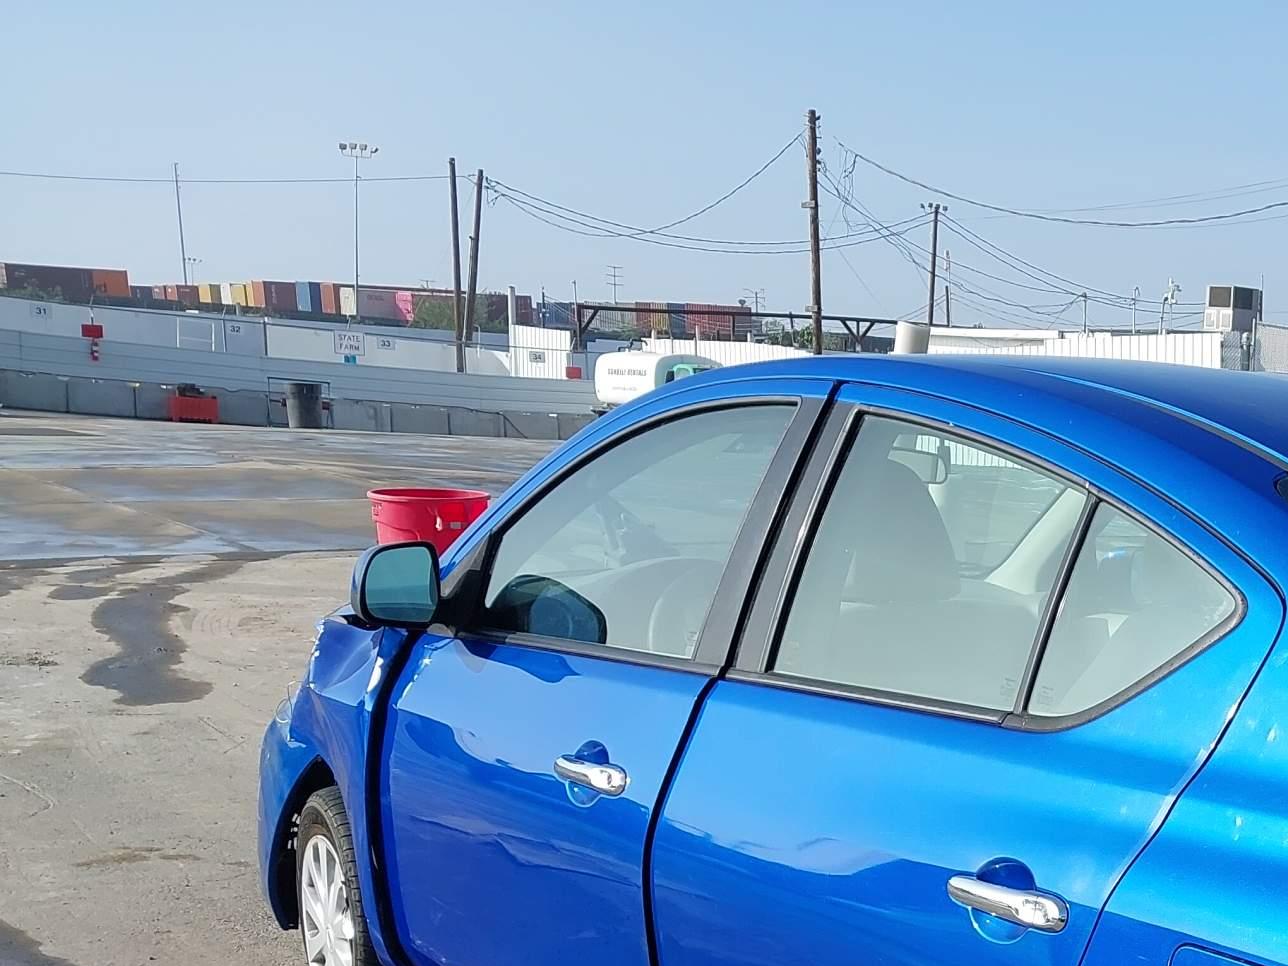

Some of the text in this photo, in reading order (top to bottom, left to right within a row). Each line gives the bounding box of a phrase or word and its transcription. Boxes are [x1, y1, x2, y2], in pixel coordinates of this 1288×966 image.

[35, 307, 47, 315] 31
[230, 325, 241, 333] 32
[337, 334, 361, 343] STATE
[380, 339, 391, 347] 33
[339, 343, 360, 352] FARM
